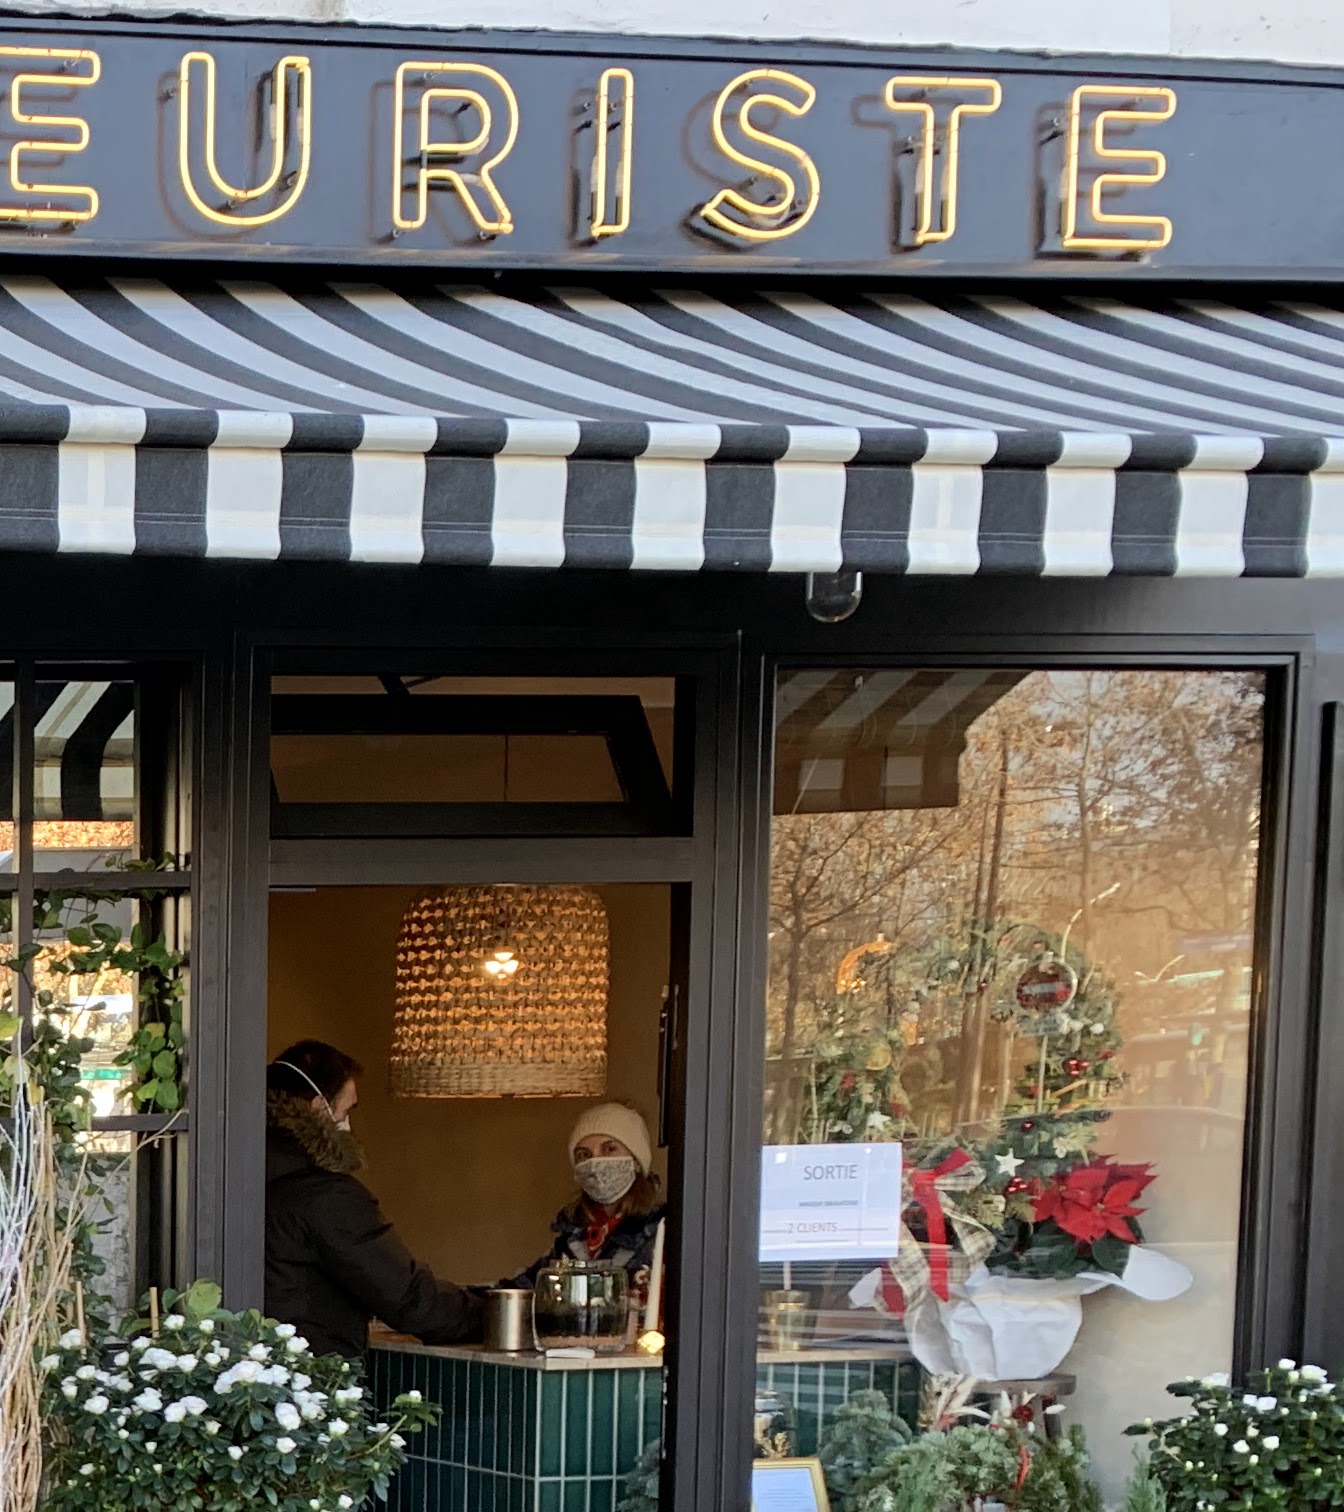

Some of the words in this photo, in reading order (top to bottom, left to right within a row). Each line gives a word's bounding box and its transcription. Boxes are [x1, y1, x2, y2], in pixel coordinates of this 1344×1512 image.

[803, 1164, 858, 1180] SORTIE
[788, 1223, 795, 1233] 2
[797, 1222, 838, 1233] CLIENTS
